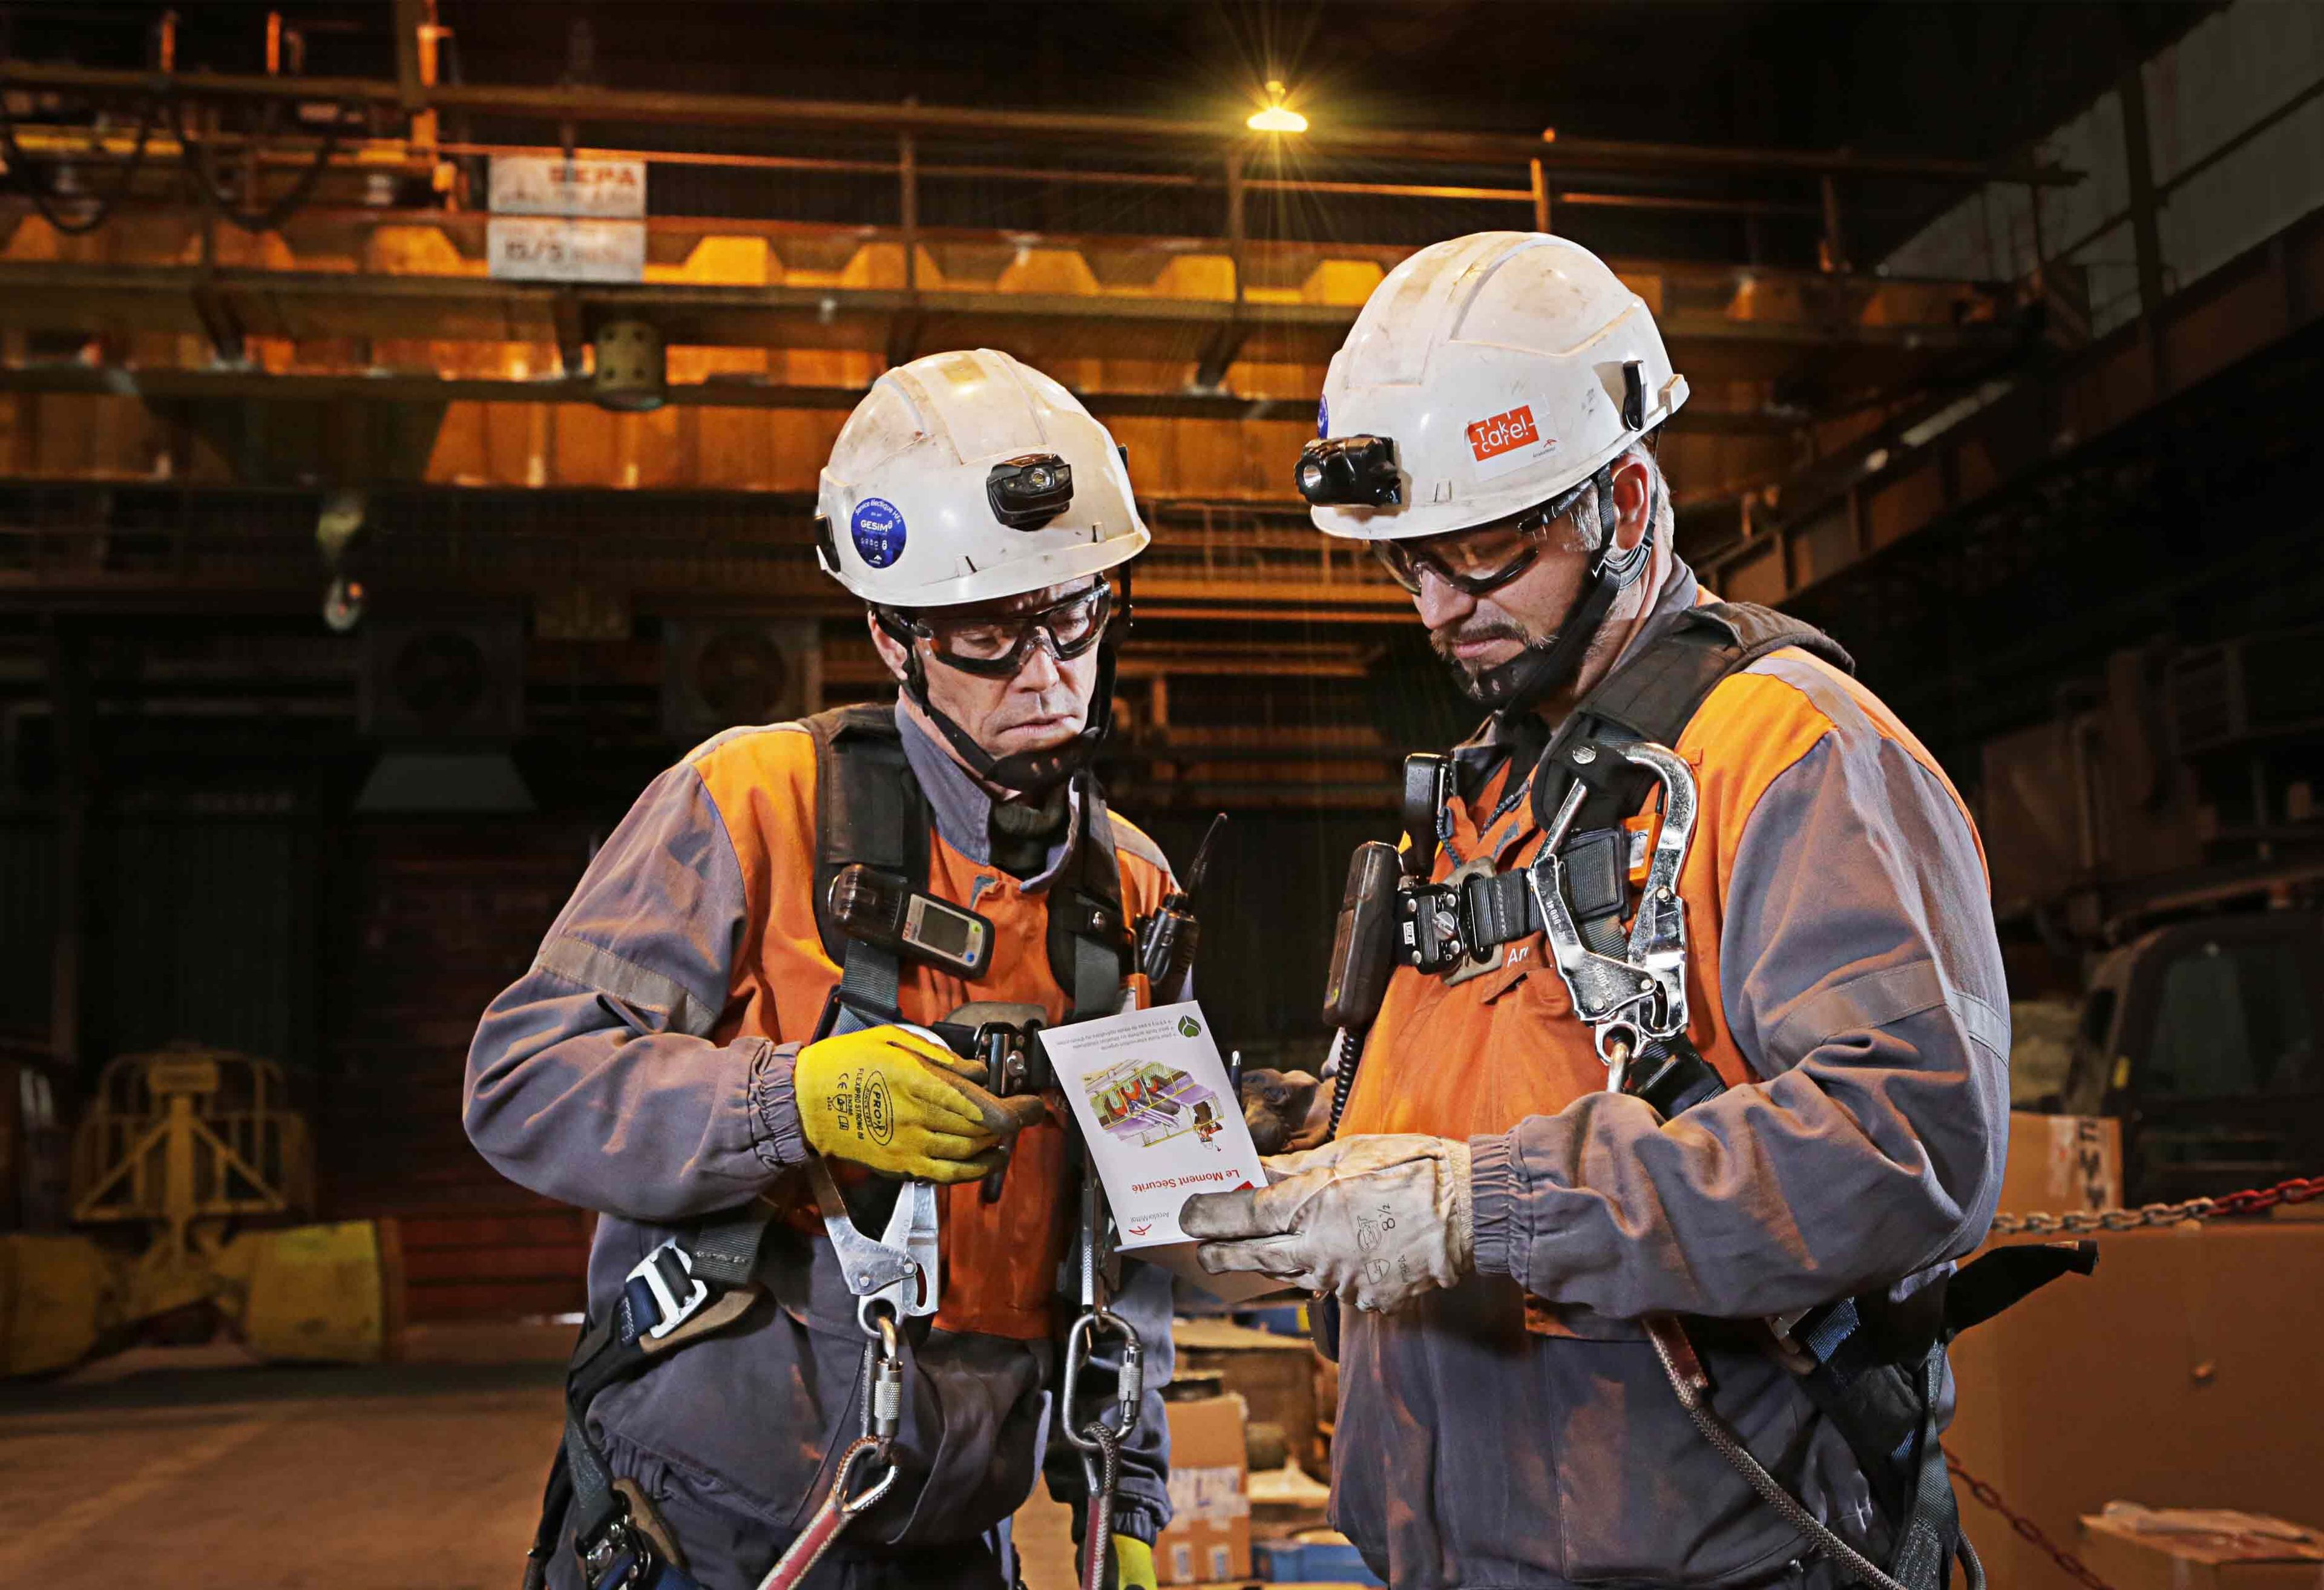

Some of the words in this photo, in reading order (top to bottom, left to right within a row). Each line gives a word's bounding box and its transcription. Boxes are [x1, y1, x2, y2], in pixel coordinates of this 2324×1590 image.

[861, 519, 888, 533] GESIM
[855, 1068, 864, 1103] FLEXIPRO
[855, 1103, 864, 1131] STRONG
[1178, 1172, 1224, 1186] Moment
[1226, 1169, 1241, 1178] Le
[1132, 1178, 1177, 1194] Sécurité
[1130, 1212, 1170, 1223] ArcelorMittal
